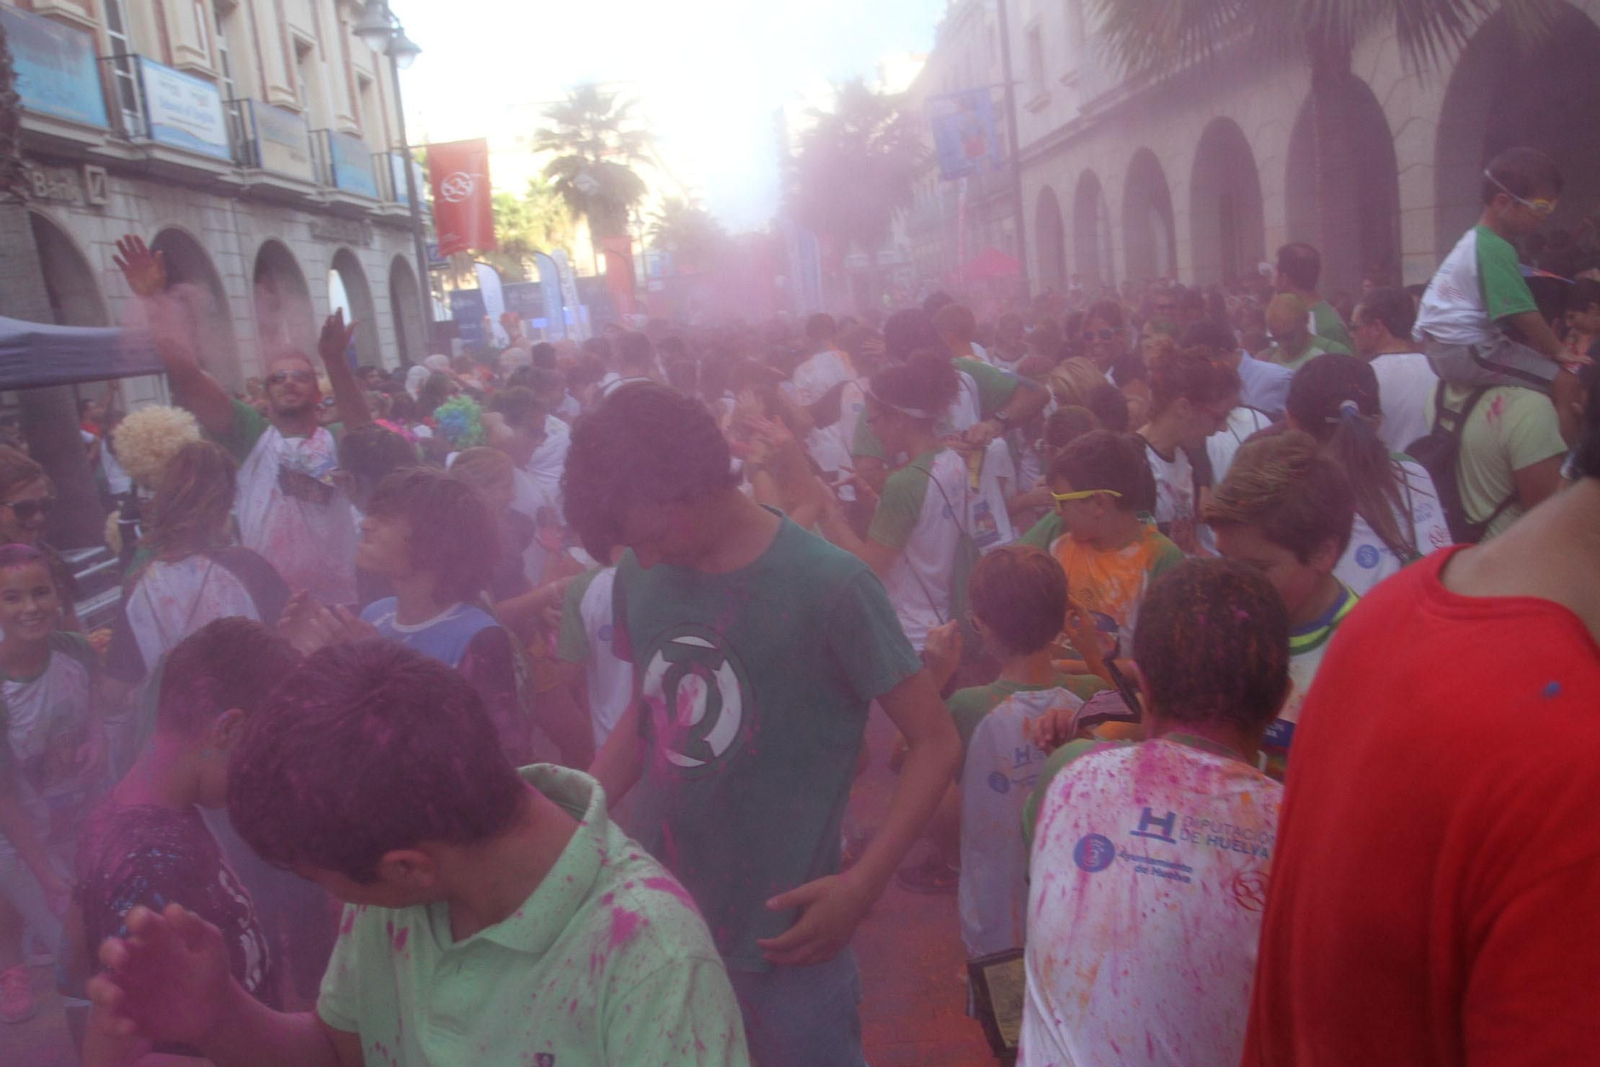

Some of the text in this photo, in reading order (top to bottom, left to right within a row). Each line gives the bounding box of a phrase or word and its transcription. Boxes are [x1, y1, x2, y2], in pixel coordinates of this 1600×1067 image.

[1179, 828, 1270, 860] DE HUELVA
[1152, 867, 1191, 885] Huelva
